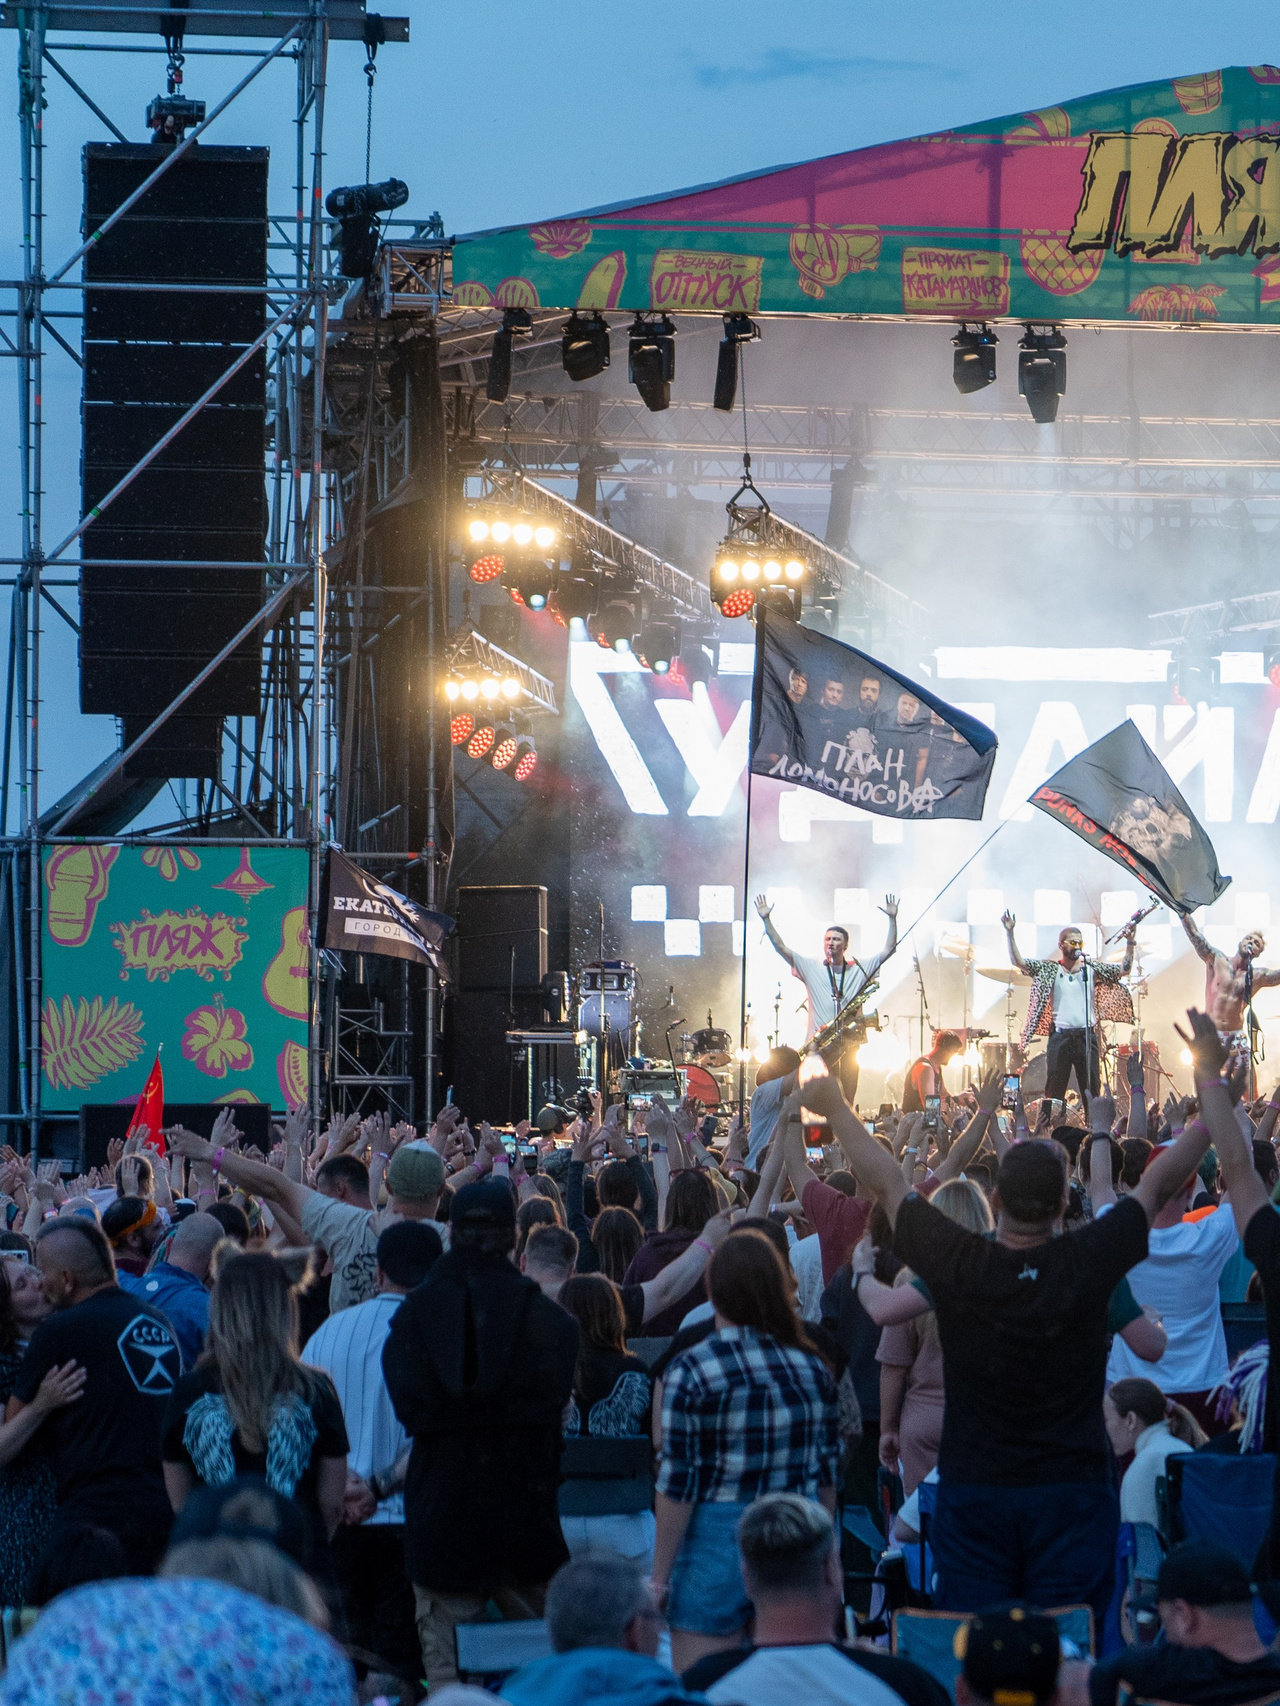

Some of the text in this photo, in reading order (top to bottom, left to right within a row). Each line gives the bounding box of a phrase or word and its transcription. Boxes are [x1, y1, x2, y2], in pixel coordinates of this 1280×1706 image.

[673, 254, 732, 270] ВЕЧНЫЙ
[917, 251, 977, 271] ПРОКАТ
[655, 270, 758, 309] ОТПУСК
[904, 270, 1002, 299] КАТАМАРАНОВ
[130, 922, 225, 961] ПЛЯЖ
[354, 922, 401, 937] ГОРОД
